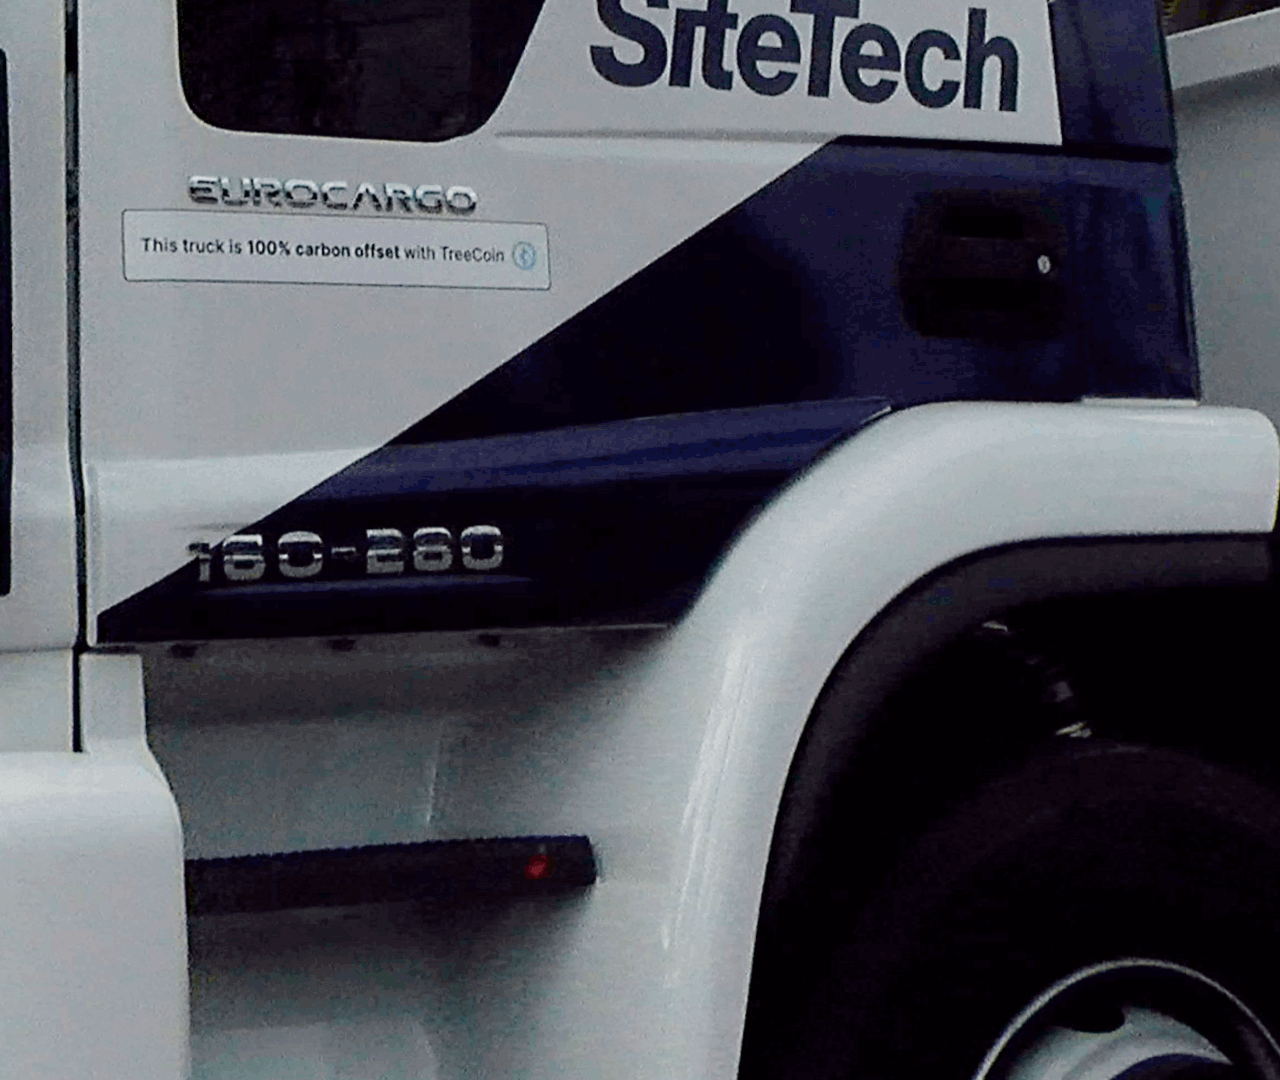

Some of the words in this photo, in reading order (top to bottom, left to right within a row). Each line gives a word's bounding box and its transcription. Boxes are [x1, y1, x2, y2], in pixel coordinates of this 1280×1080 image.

[187, 175, 479, 216] EUROCARGO
[141, 237, 178, 254] This
[183, 238, 226, 255] truck
[229, 239, 243, 255] is
[247, 240, 291, 257] 100%
[295, 242, 351, 258] carbon
[354, 243, 400, 260] offset
[403, 245, 436, 261] with
[440, 246, 505, 263] TreeCoin
[186, 524, 504, 583] 160-280
